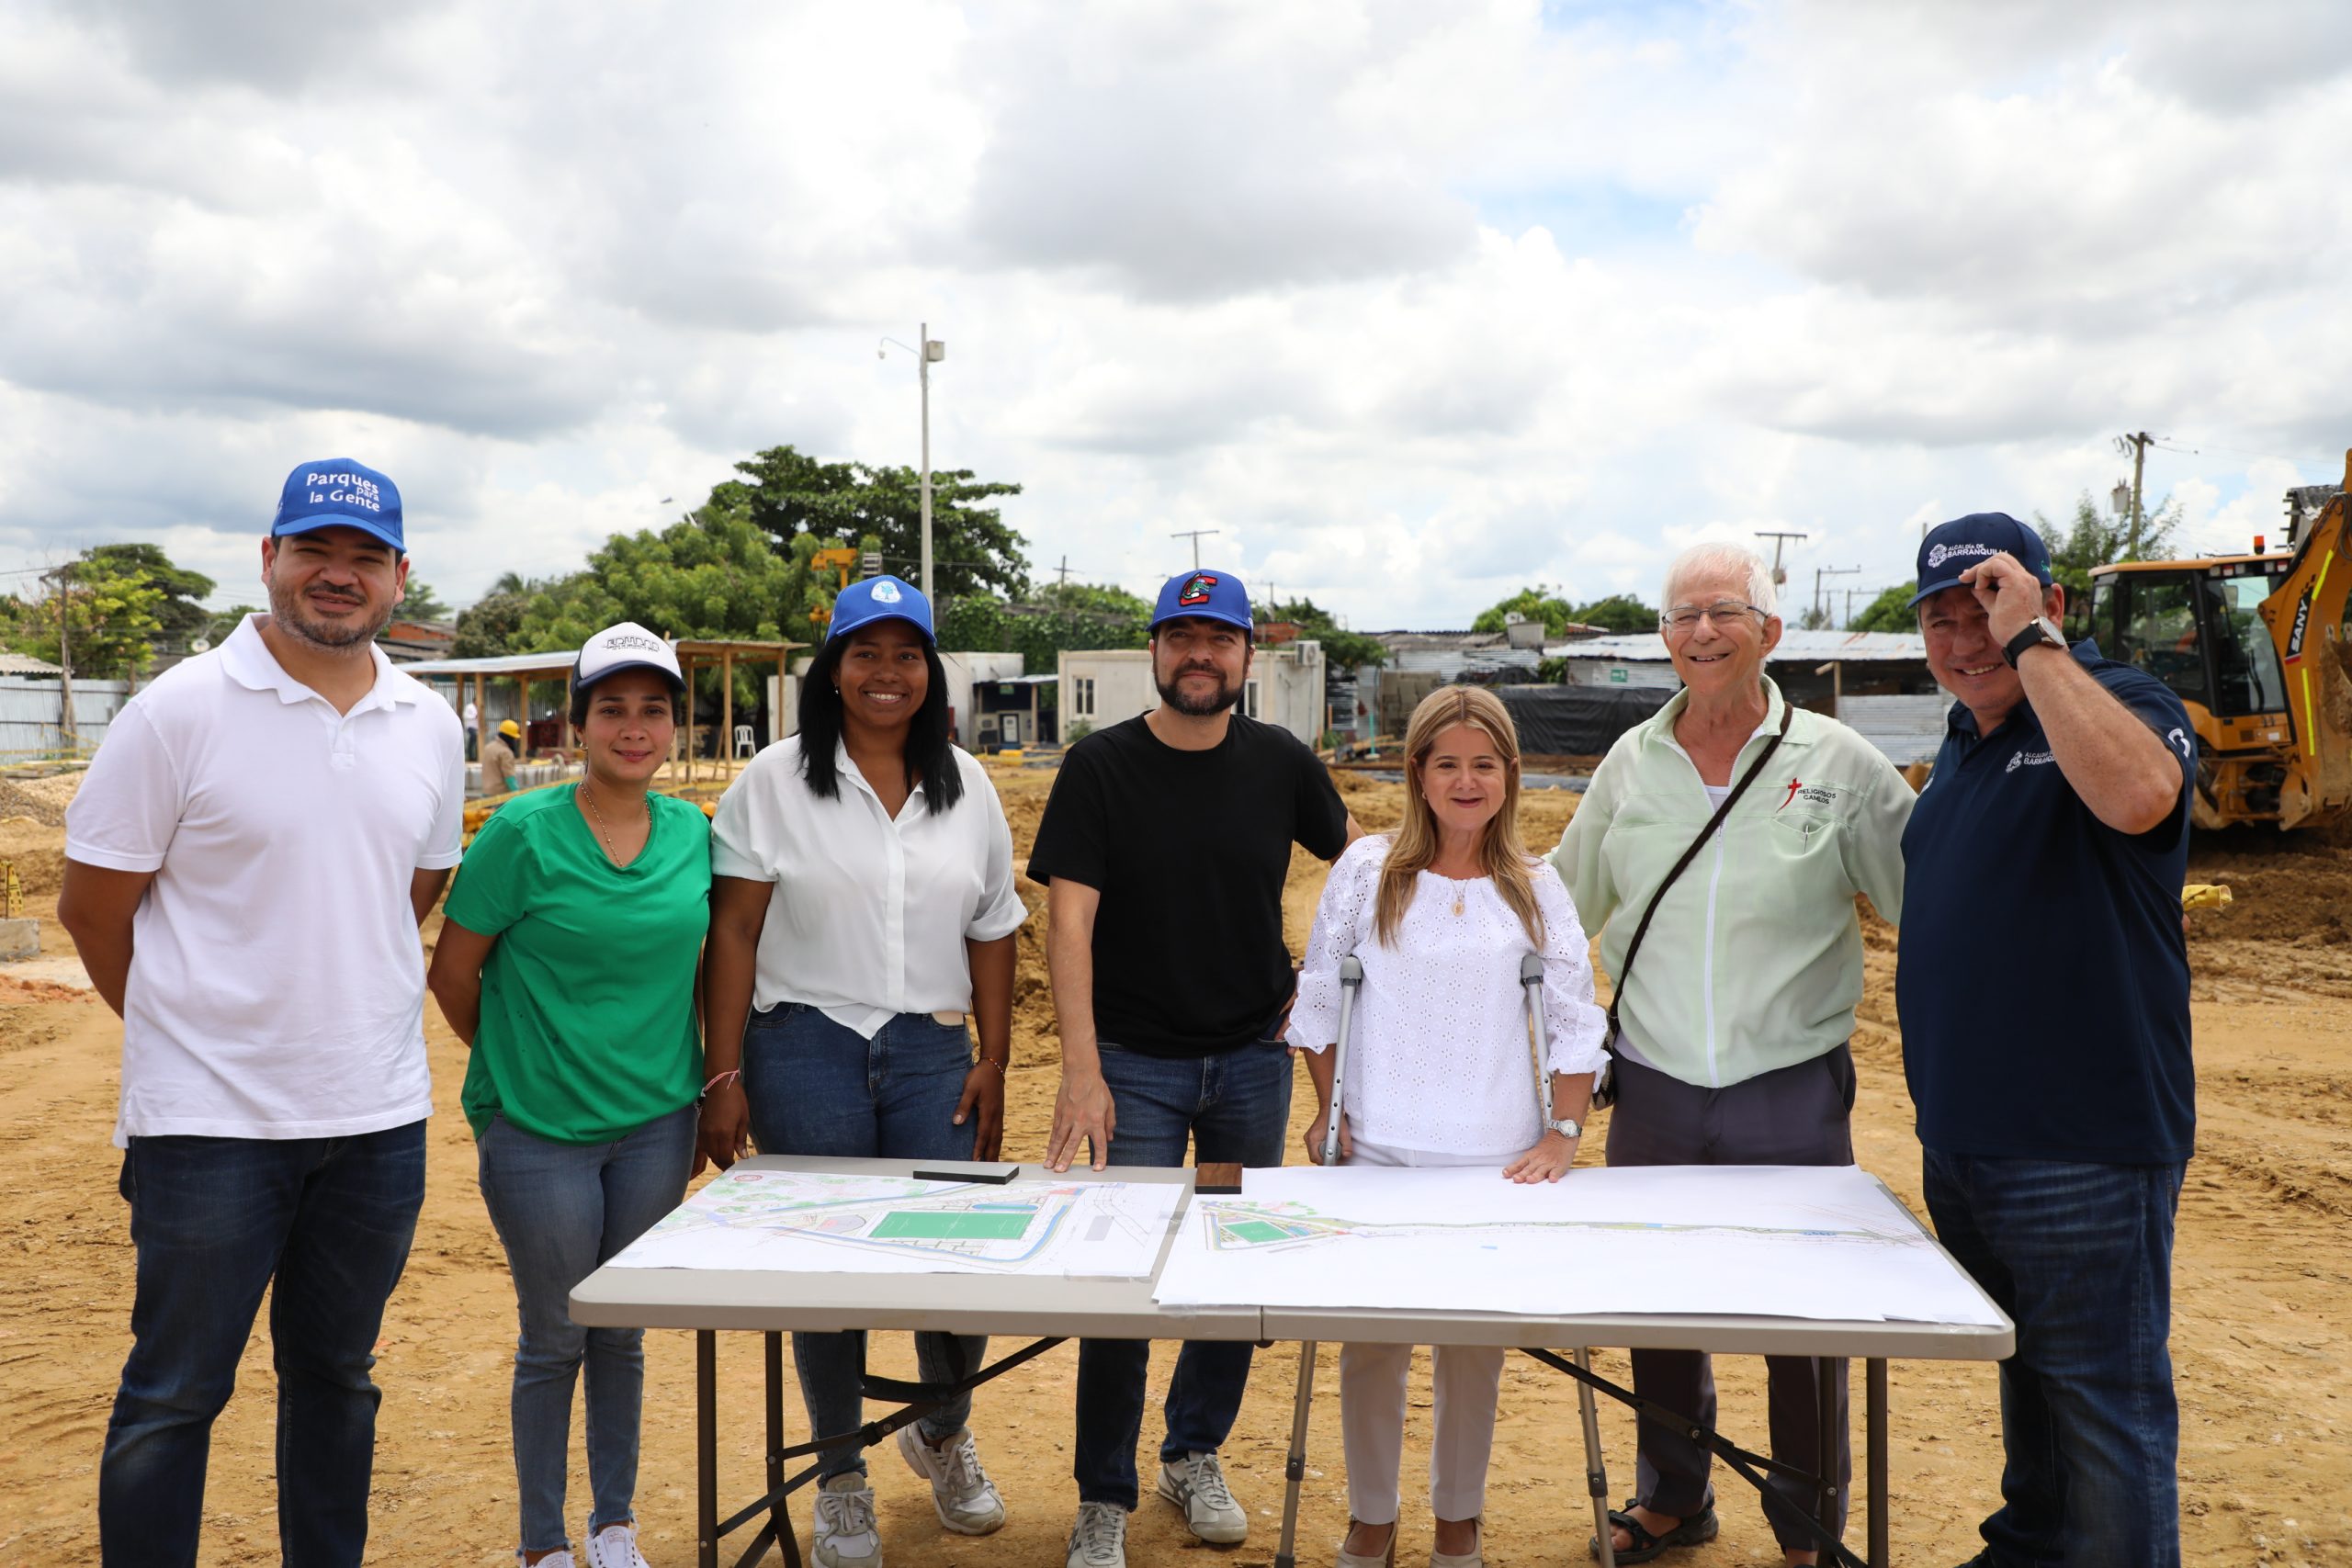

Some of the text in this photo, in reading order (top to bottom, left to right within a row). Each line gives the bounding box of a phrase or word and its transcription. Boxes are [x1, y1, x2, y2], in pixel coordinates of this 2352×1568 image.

[306, 472, 379, 494] Parques
[356, 486, 379, 502] para
[309, 490, 379, 512] la Gente
[2290, 599, 2308, 652] SANY
[1797, 788, 1837, 799] RELIGIOSOS
